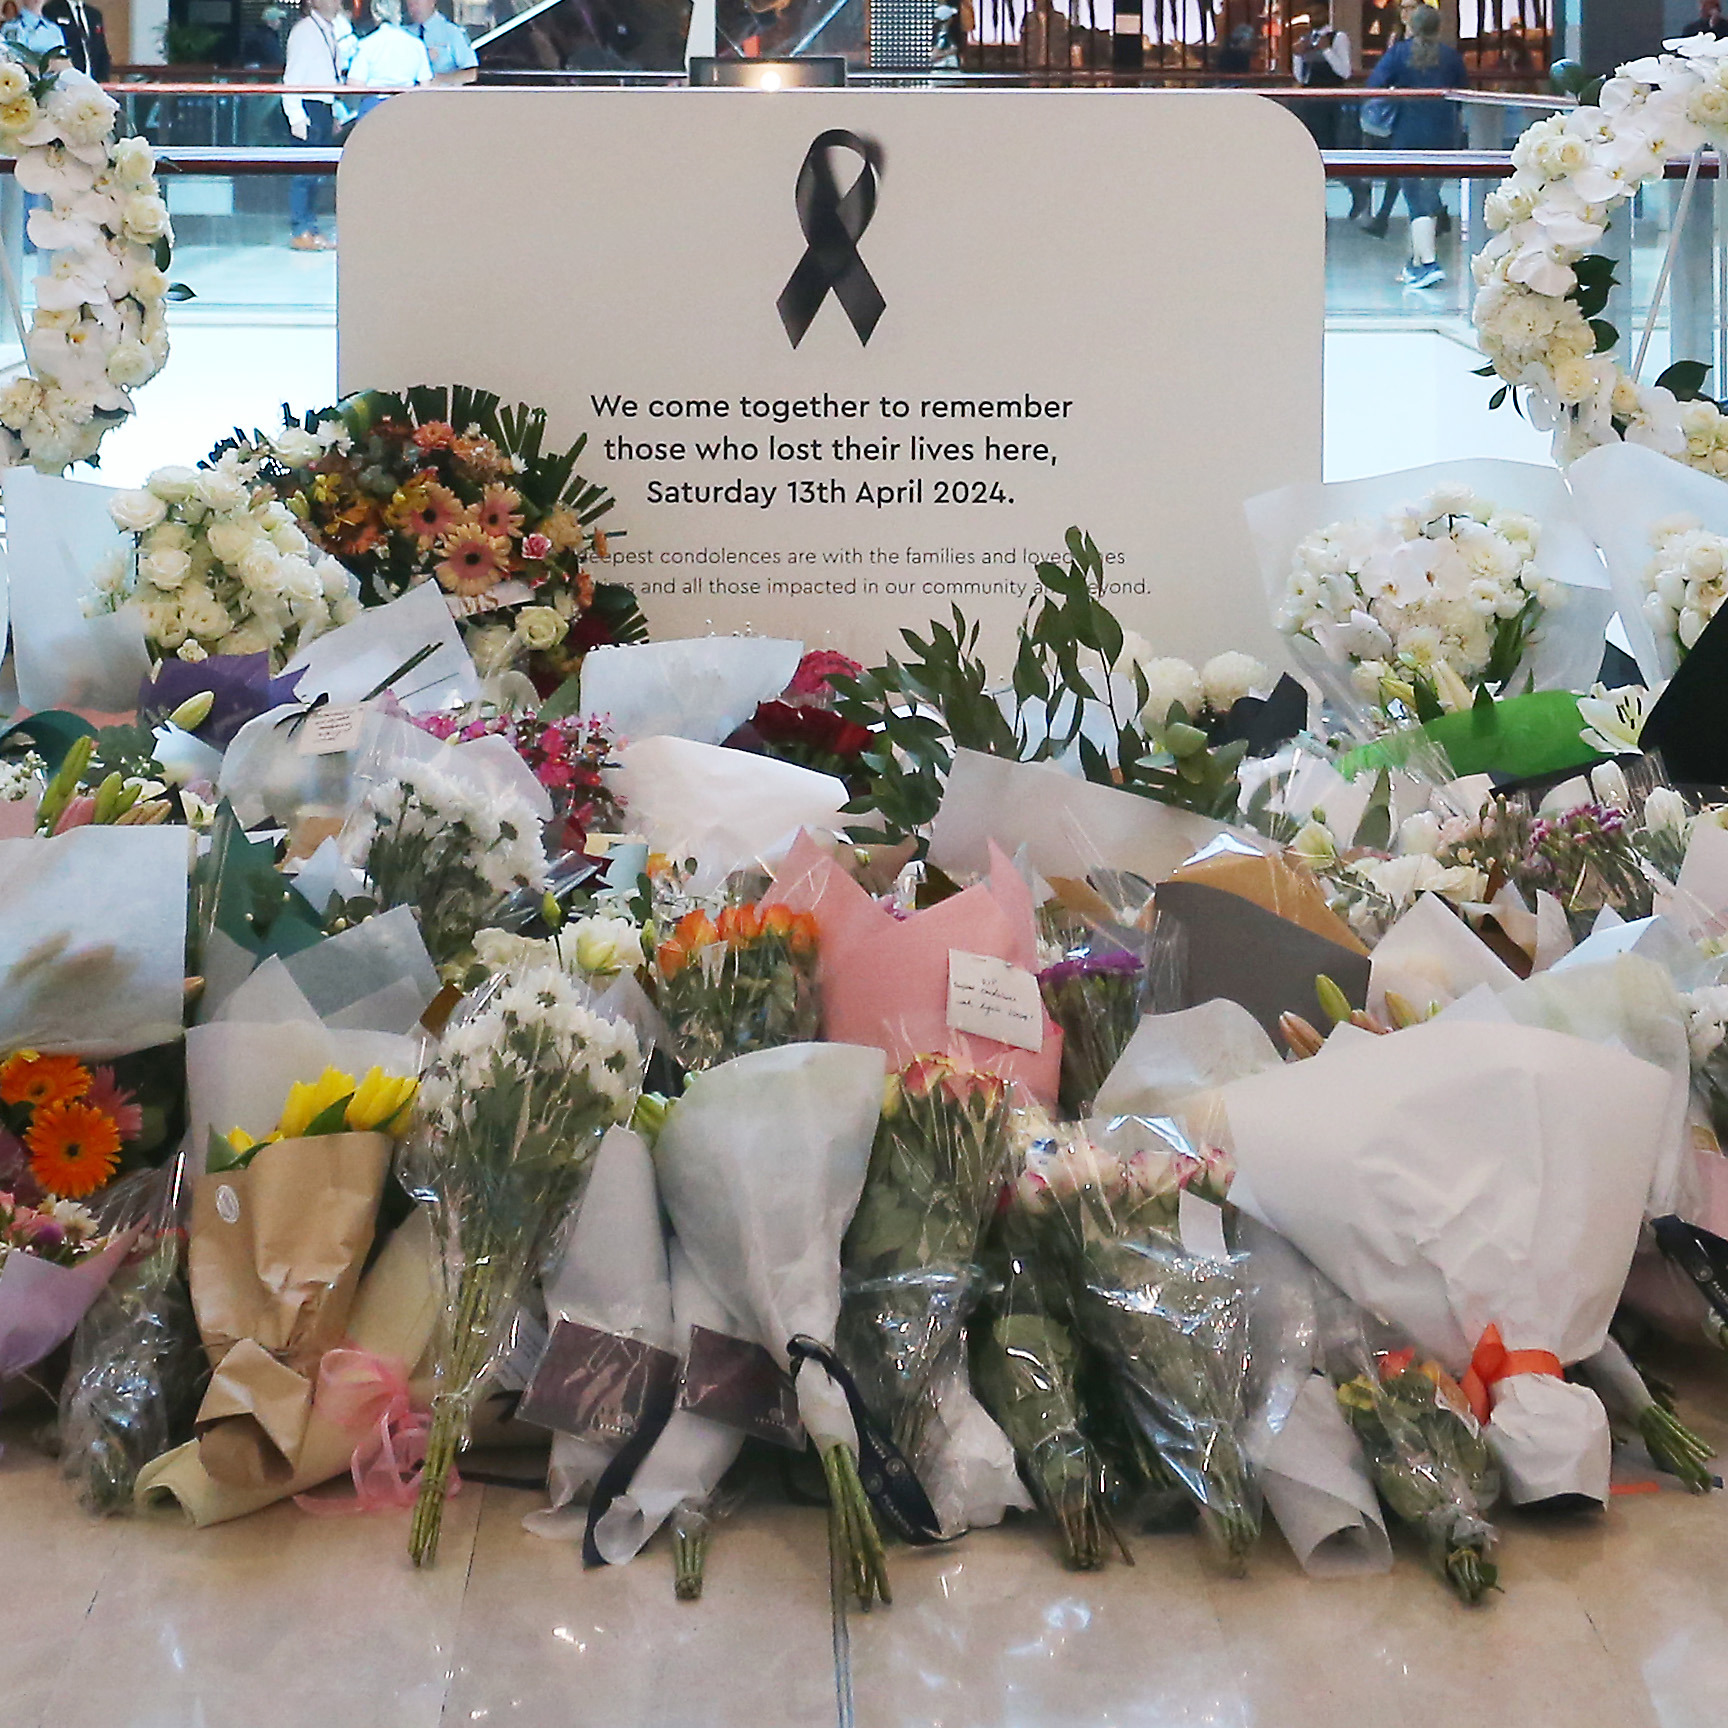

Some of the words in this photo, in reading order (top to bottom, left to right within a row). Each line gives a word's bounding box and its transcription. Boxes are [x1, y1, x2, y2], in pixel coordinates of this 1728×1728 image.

[590, 394, 638, 417] We
[648, 399, 730, 417] come
[740, 392, 870, 423] together
[879, 396, 910, 417] to
[921, 393, 1073, 417] remember
[604, 435, 686, 460] those
[696, 435, 758, 460] who
[770, 435, 822, 460] lost
[832, 435, 901, 460] their
[911, 435, 974, 460] lives
[986, 435, 1057, 466] here,
[647, 478, 777, 509] Saturday
[787, 478, 846, 503] 13th
[855, 478, 922, 509] April
[934, 480, 1014, 504] 2024.
[660, 548, 780, 564] condolences
[788, 551, 816, 564] are
[822, 548, 863, 564] with
[870, 548, 900, 564] the
[906, 547, 975, 564] families
[981, 548, 1017, 564] and
[641, 578, 675, 594] and
[682, 578, 702, 594] all
[709, 579, 761, 594] those
[767, 578, 856, 598] impacted
[863, 579, 878, 594] in
[885, 582, 915, 594] our
[922, 579, 1027, 598] community
